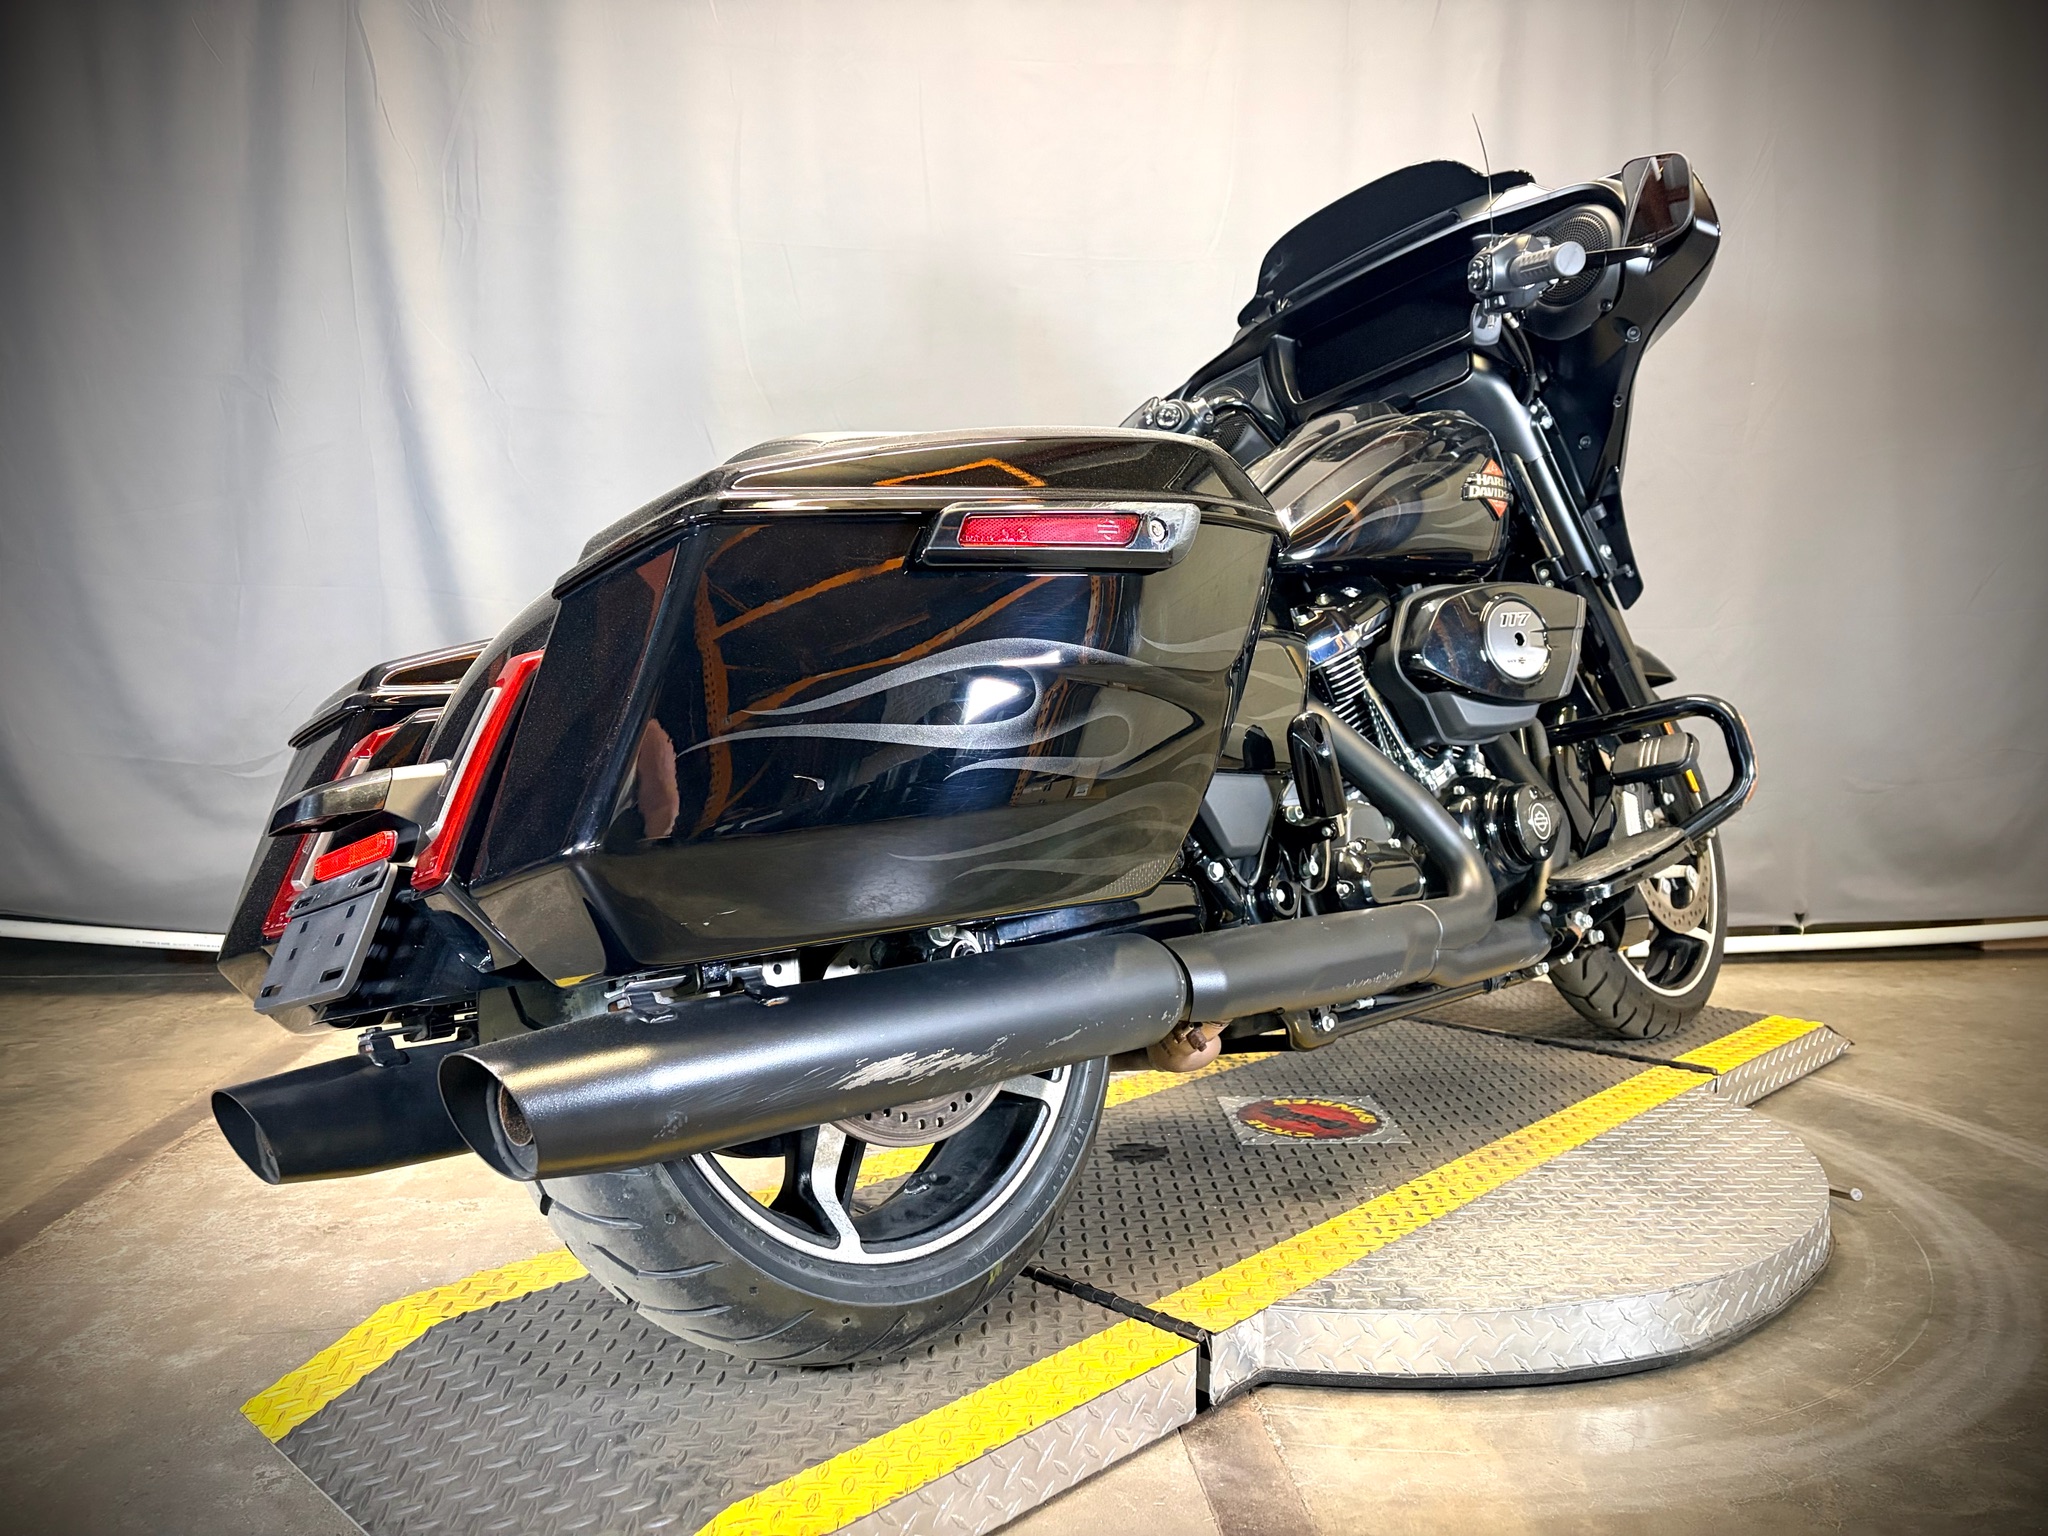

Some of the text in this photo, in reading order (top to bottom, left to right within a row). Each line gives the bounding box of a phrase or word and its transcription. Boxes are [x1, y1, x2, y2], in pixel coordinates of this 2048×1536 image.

[1476, 473, 1511, 488] HARL
[1500, 612, 1531, 627] 117
[1245, 1119, 1314, 1138] CYCLE
